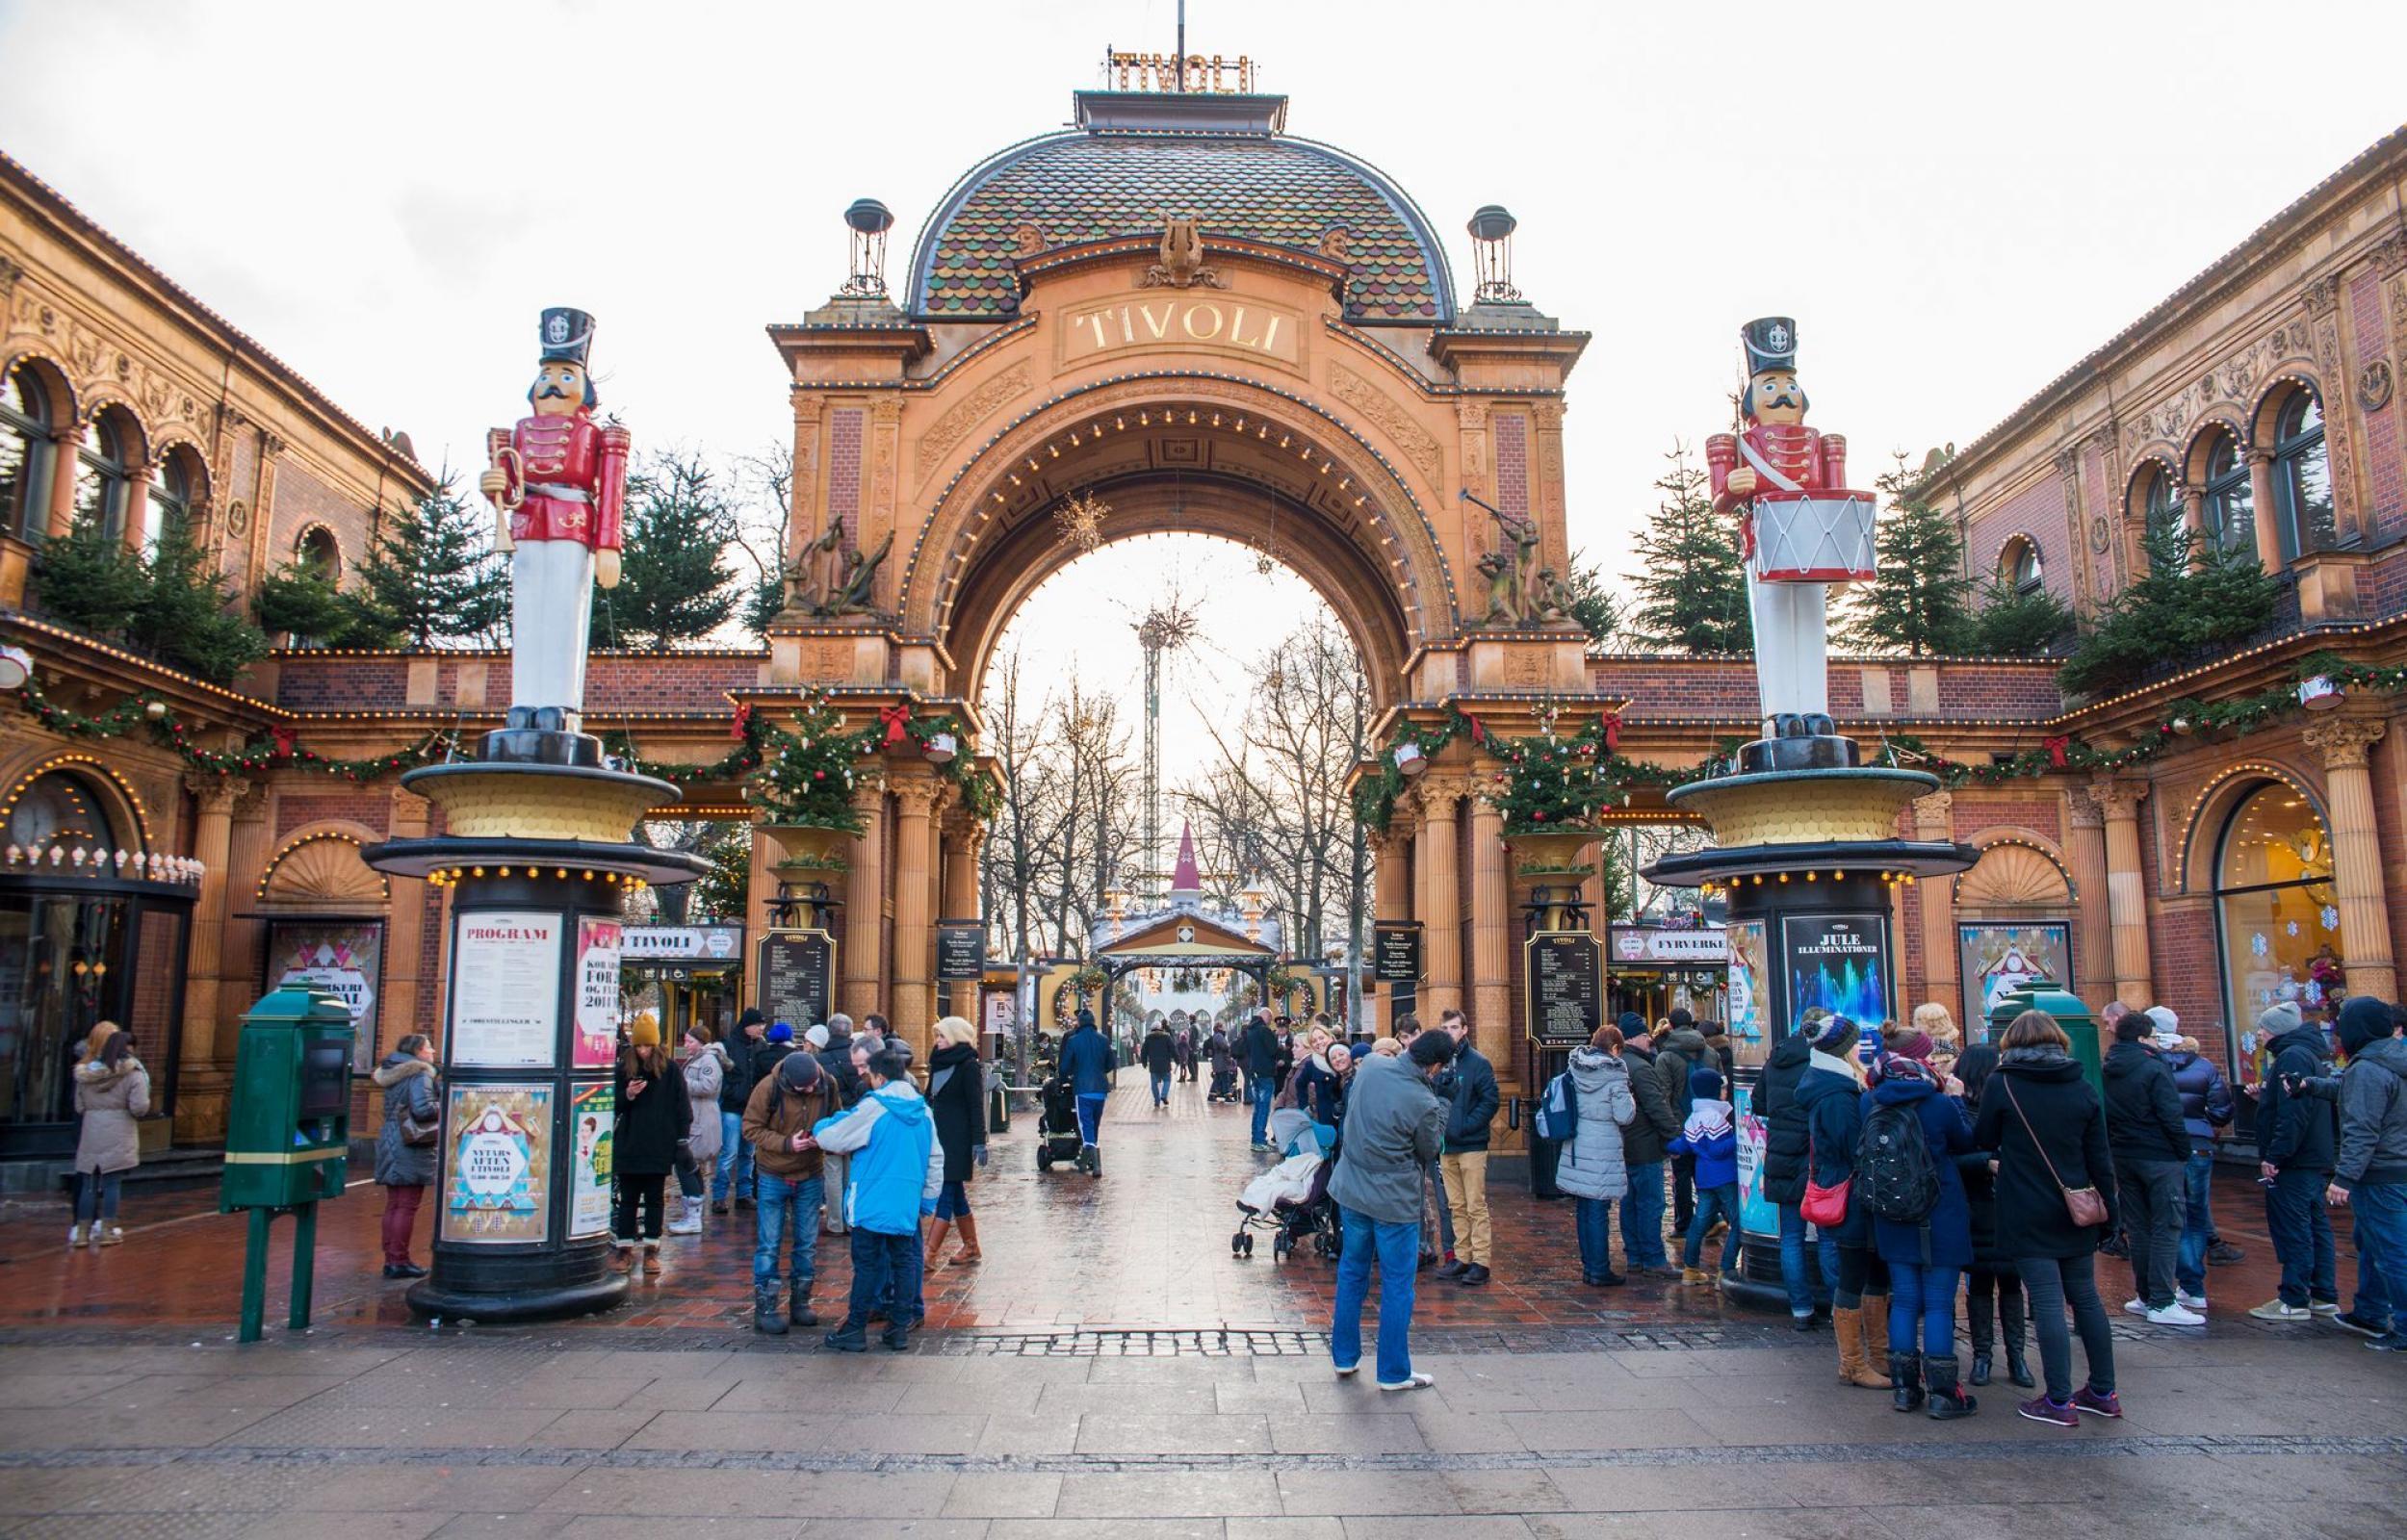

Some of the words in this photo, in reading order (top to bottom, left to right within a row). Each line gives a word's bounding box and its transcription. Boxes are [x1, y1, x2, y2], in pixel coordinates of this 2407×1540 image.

[1113, 52, 1249, 94] TIVOLI
[1075, 302, 1281, 352] TIVOLI
[467, 927, 548, 940] PROGRAM
[630, 936, 690, 948] TIVOLI
[1820, 934, 1861, 946] JULE
[1798, 945, 1877, 954] ILLUMINATIONER
